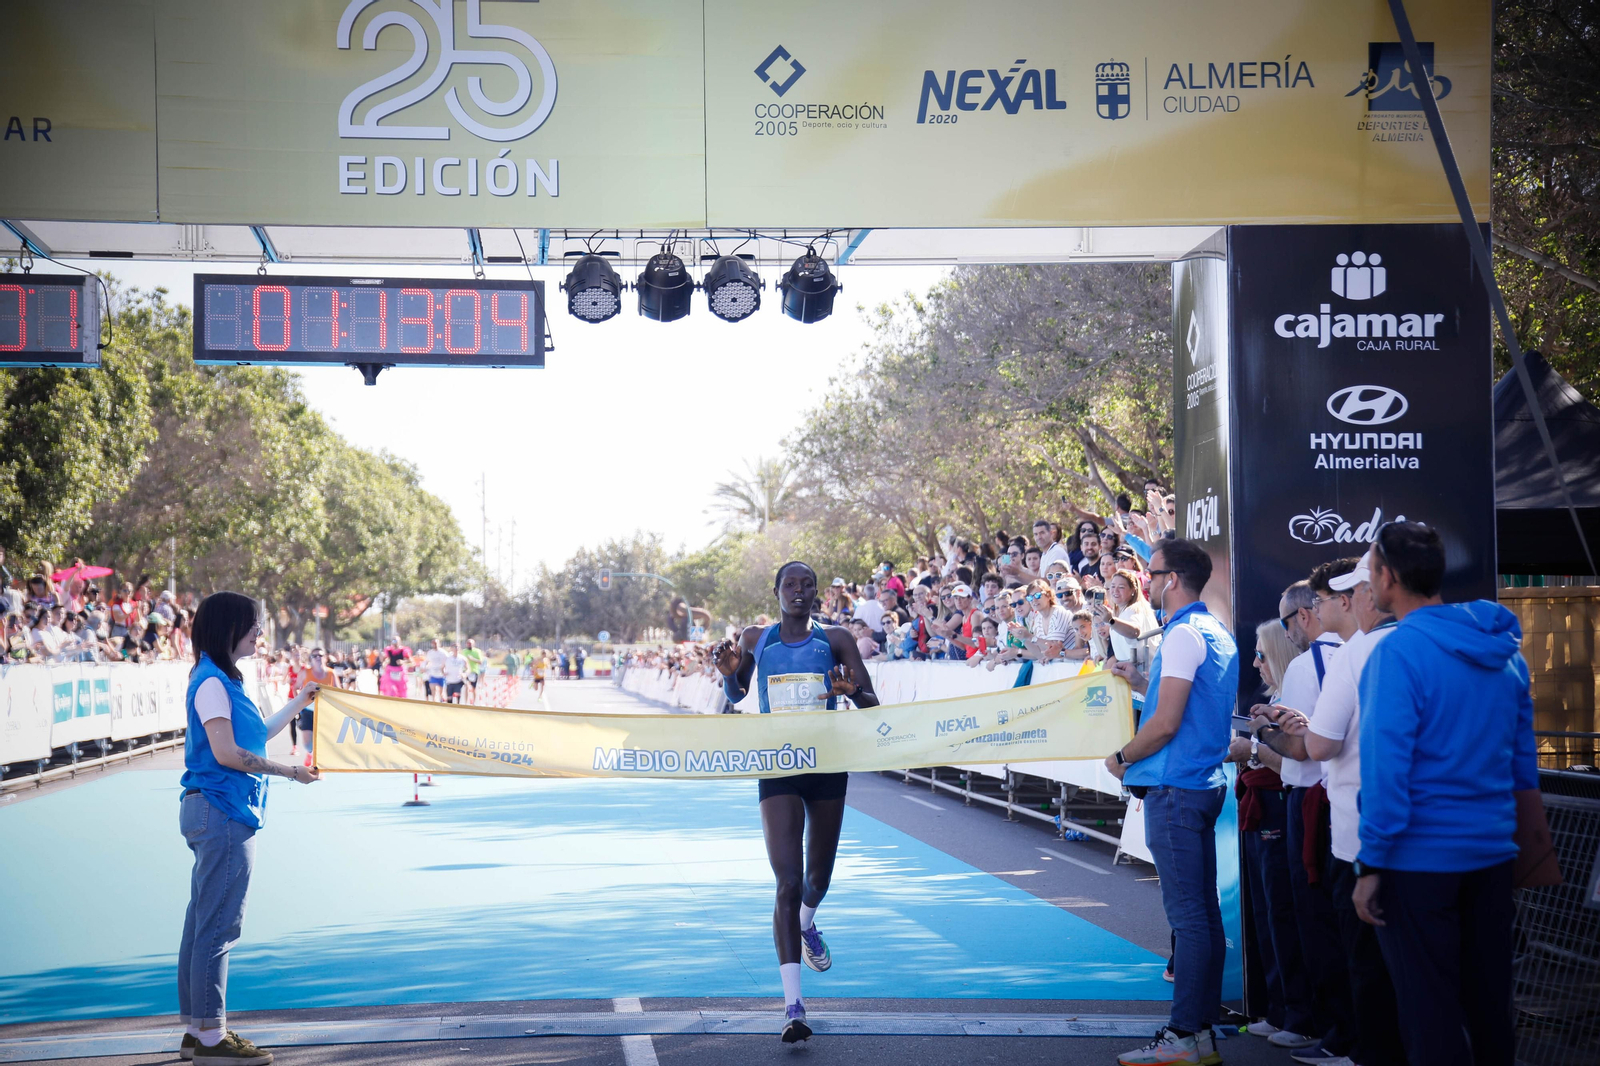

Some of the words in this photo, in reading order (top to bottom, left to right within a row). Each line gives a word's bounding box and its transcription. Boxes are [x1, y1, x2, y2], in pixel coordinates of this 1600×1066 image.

[336, 0, 558, 142] 25
[1162, 54, 1316, 90] ALMERÍA
[754, 101, 884, 120] COOPERACIÓN
[1162, 95, 1240, 113] CIUDAD
[802, 120, 834, 129] Deporte,
[928, 114, 959, 124] 2020
[1356, 121, 1420, 131] DEPORTES
[754, 120, 799, 136] 2005
[338, 148, 560, 197] EDICIÓN
[1273, 303, 1445, 349] cajamar
[1356, 340, 1392, 351] CAJA
[1395, 340, 1440, 351] RURAL
[1309, 432, 1423, 450] HYUNDAI
[1314, 453, 1420, 469] Almerialva
[786, 683, 810, 699] 16
[425, 732, 470, 747] Medio
[474, 736, 534, 752] Maratón
[876, 733, 916, 743] COOPERACIÓN
[490, 751, 534, 766] 2024
[592, 746, 681, 772] MEDIO
[684, 743, 817, 772] MARATÓN
